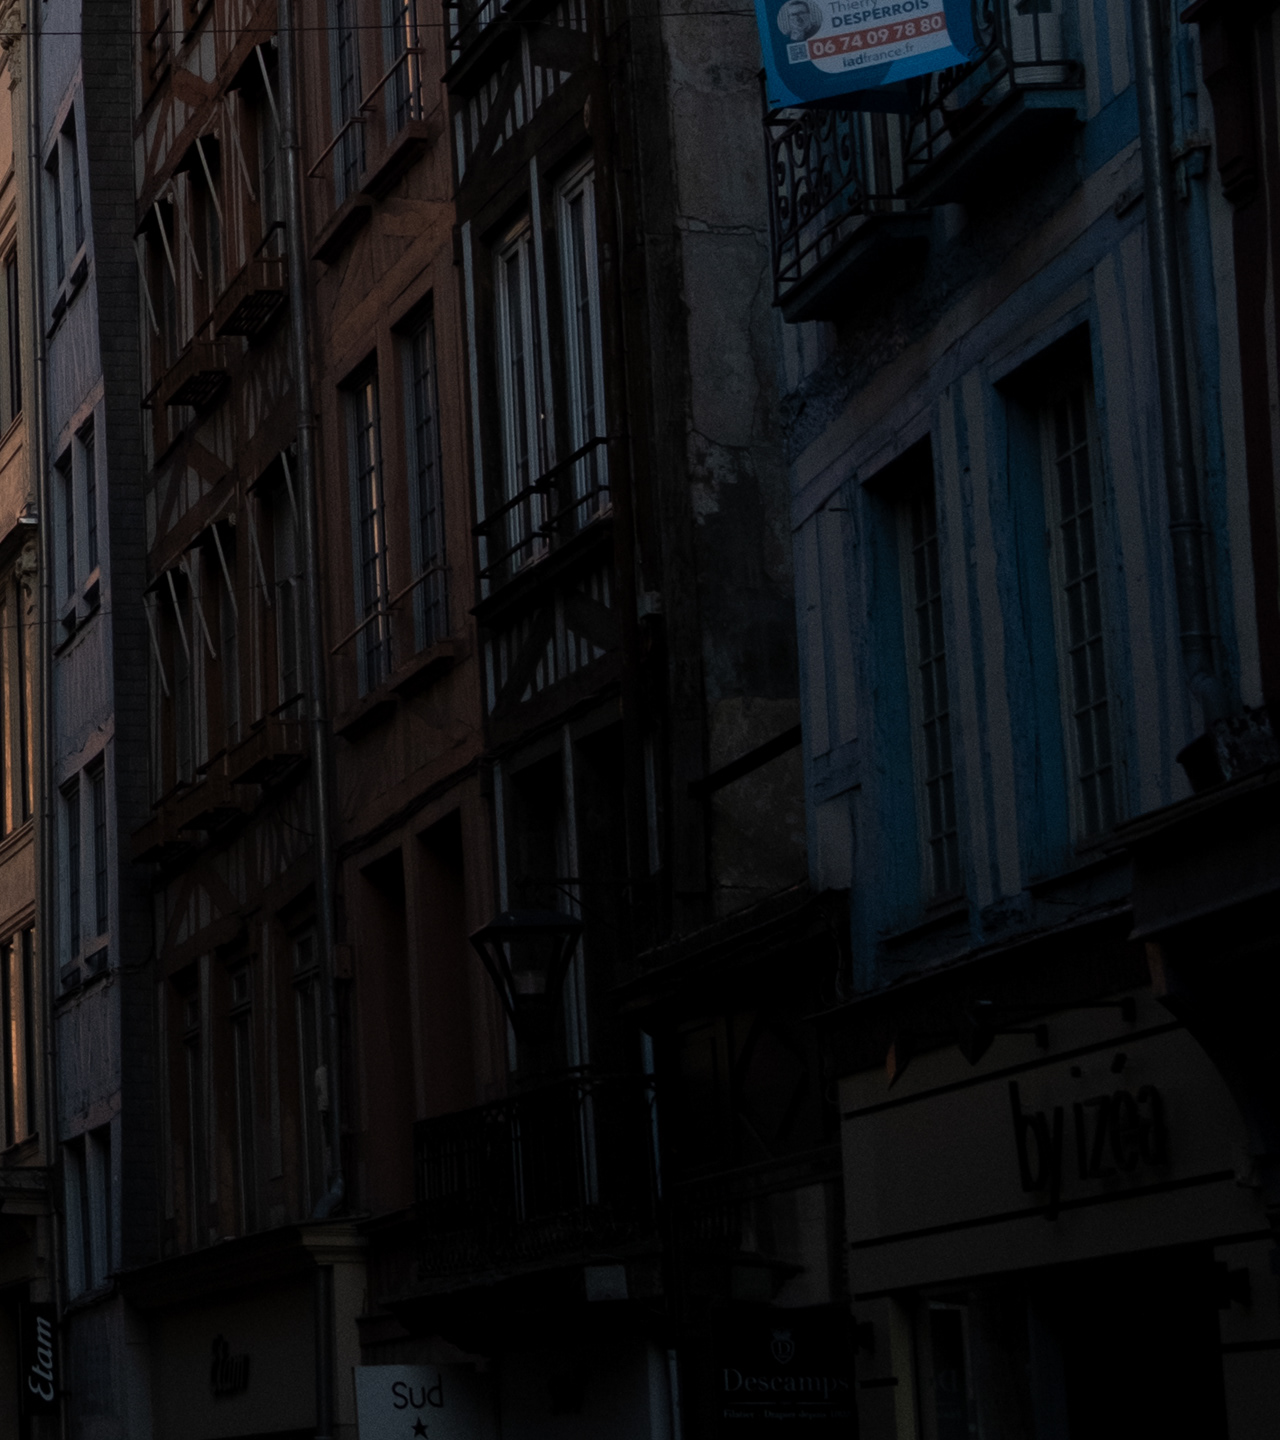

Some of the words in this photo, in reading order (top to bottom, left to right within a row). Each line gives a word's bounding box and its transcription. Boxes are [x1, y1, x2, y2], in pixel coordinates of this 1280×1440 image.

[812, 40, 835, 56] 06
[839, 35, 863, 52] 74
[866, 29, 889, 46] 09
[893, 23, 916, 41] 78
[920, 15, 943, 34] 80
[842, 42, 915, 68] iadfrance.fr
[1008, 1080, 1064, 1221] by
[1070, 1052, 1169, 1180] izéa
[27, 1315, 55, 1402] Etam
[391, 1373, 444, 1410] Sud
[721, 1367, 850, 1400] Descamps
